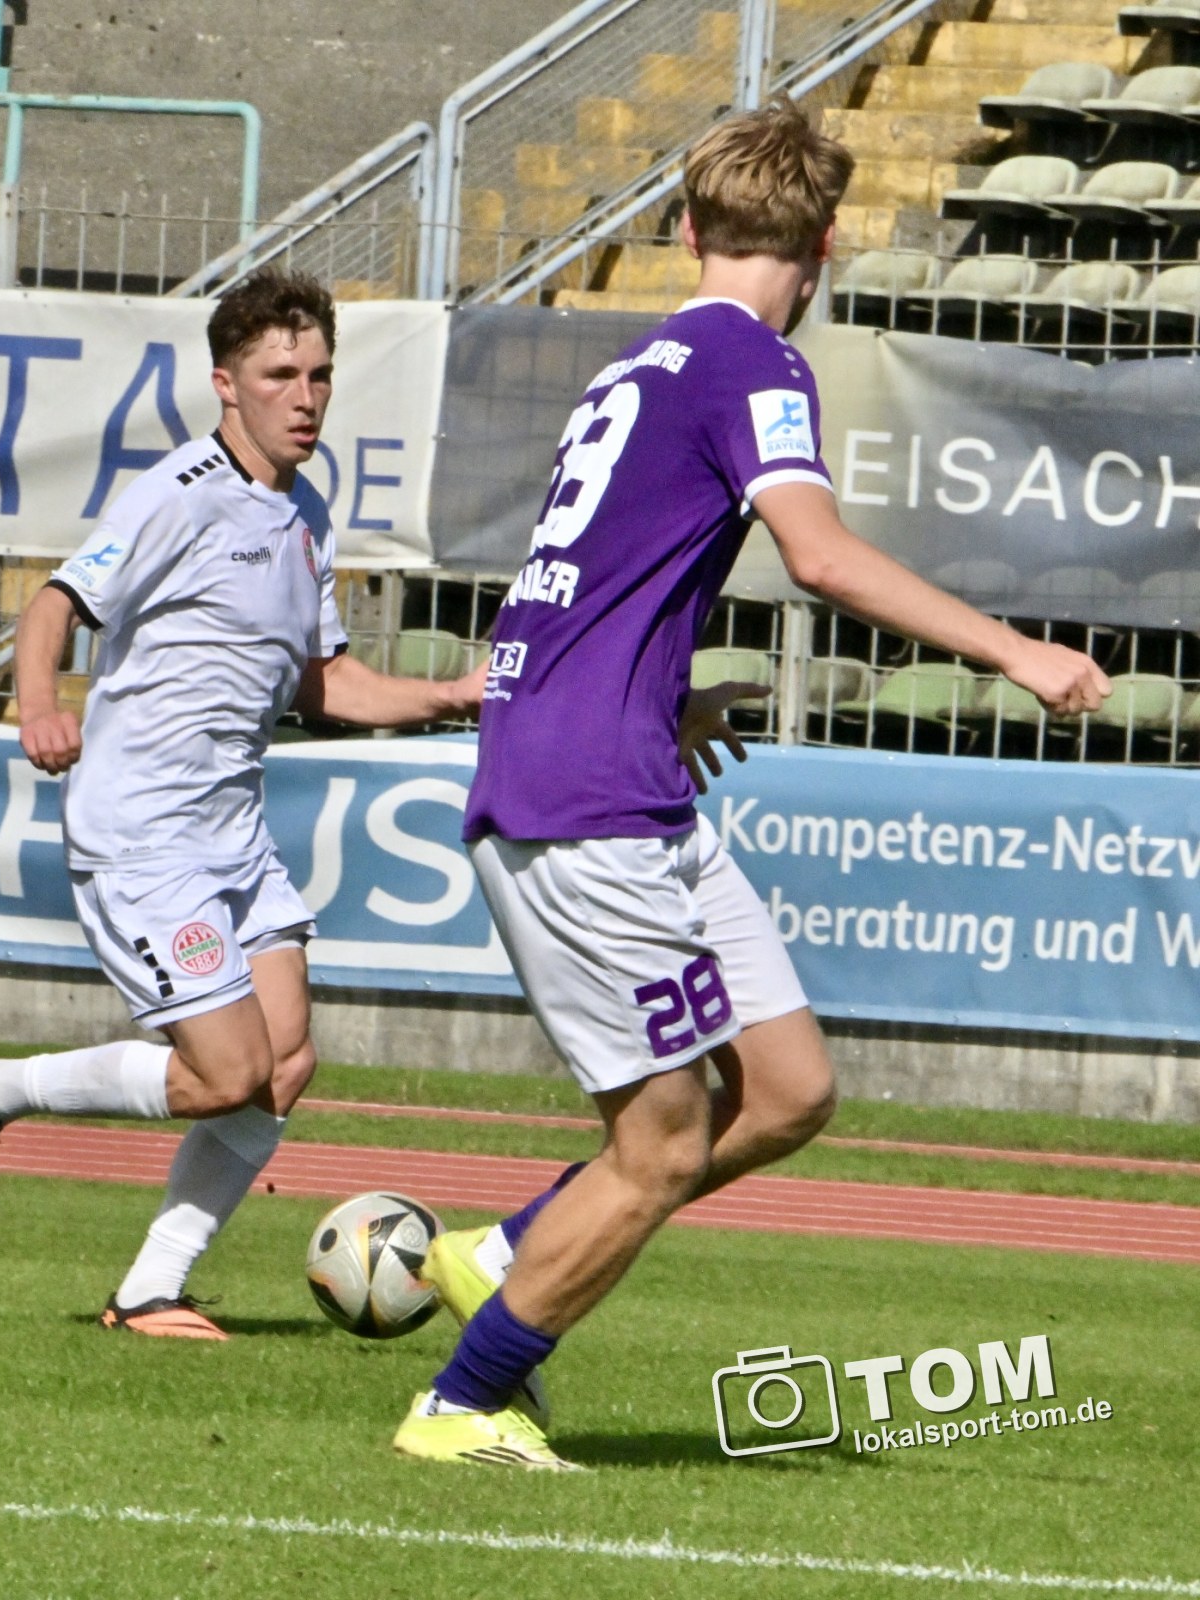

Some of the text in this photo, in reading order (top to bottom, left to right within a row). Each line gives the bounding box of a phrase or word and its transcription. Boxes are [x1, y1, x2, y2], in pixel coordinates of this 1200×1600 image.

[231, 547, 271, 564] capelli
[762, 886, 1015, 973] beratung
[1034, 907, 1138, 965] und
[633, 953, 732, 1059] 28
